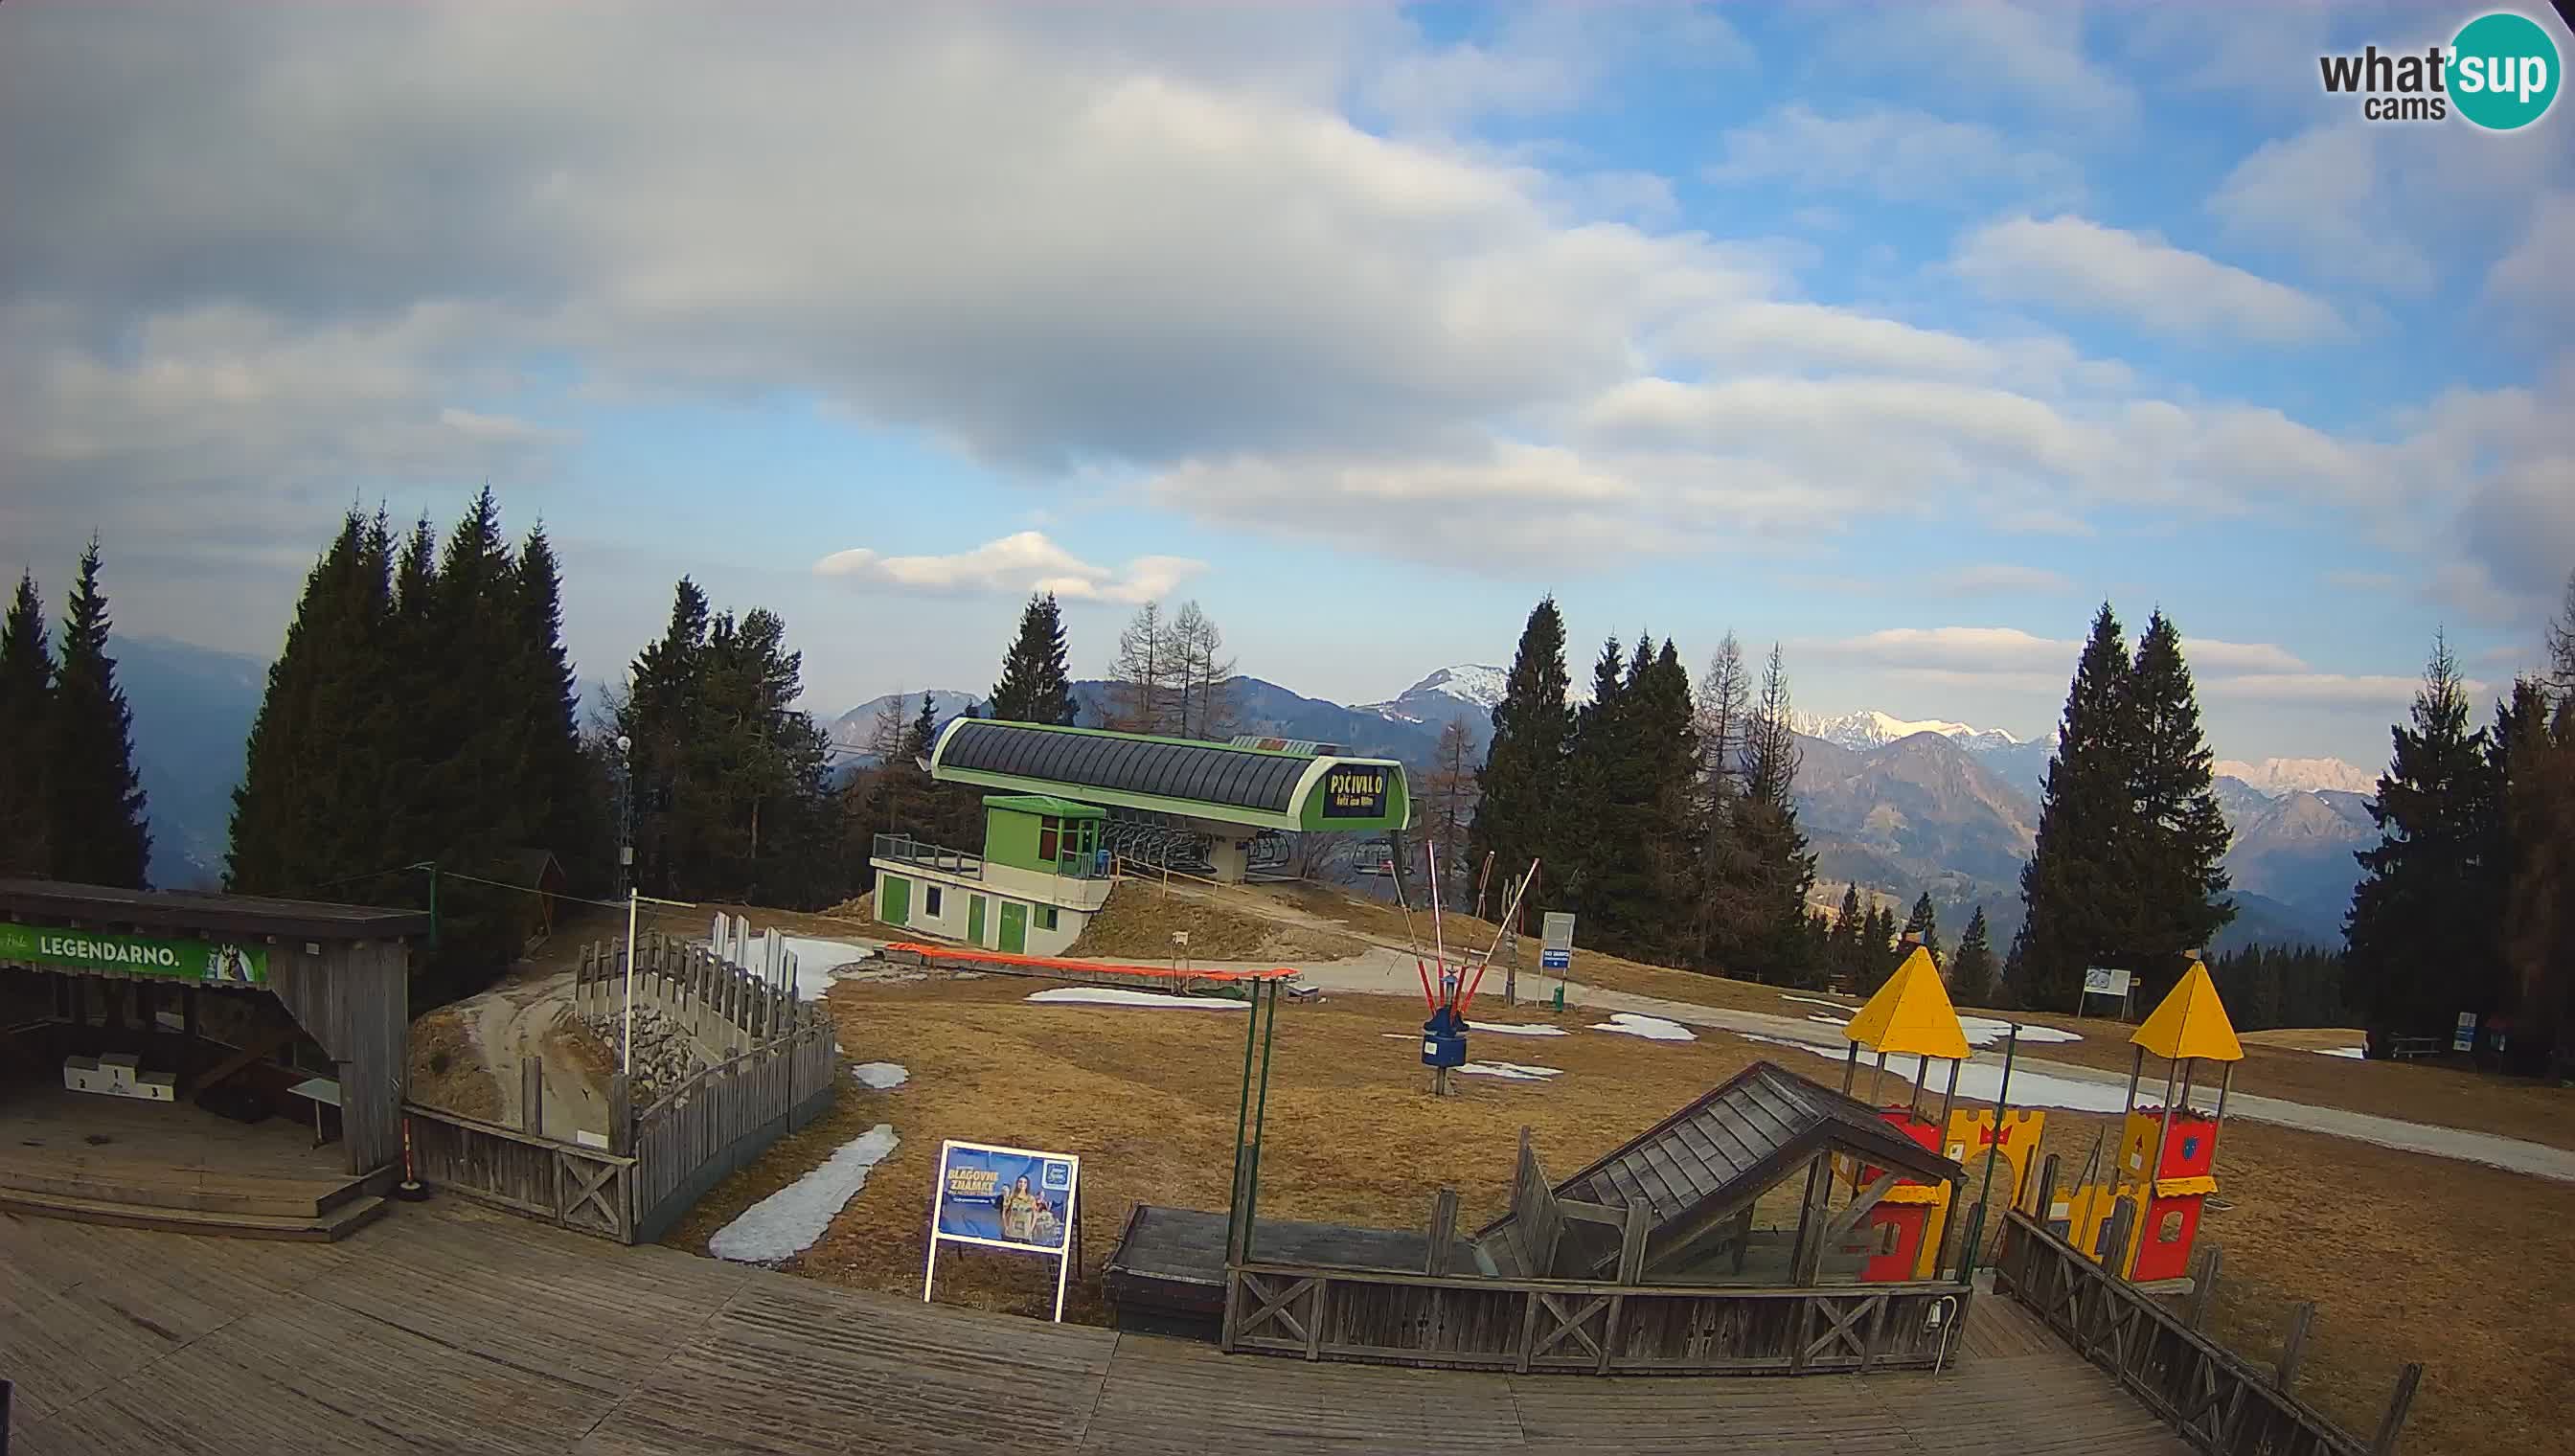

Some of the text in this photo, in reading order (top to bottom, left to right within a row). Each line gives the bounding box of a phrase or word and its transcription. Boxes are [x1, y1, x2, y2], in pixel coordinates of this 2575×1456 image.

[39, 936, 181, 967] LEGENDARNO.
[113, 1069, 120, 1080] 1
[79, 1078, 86, 1089] 2
[151, 1086, 159, 1098] 3
